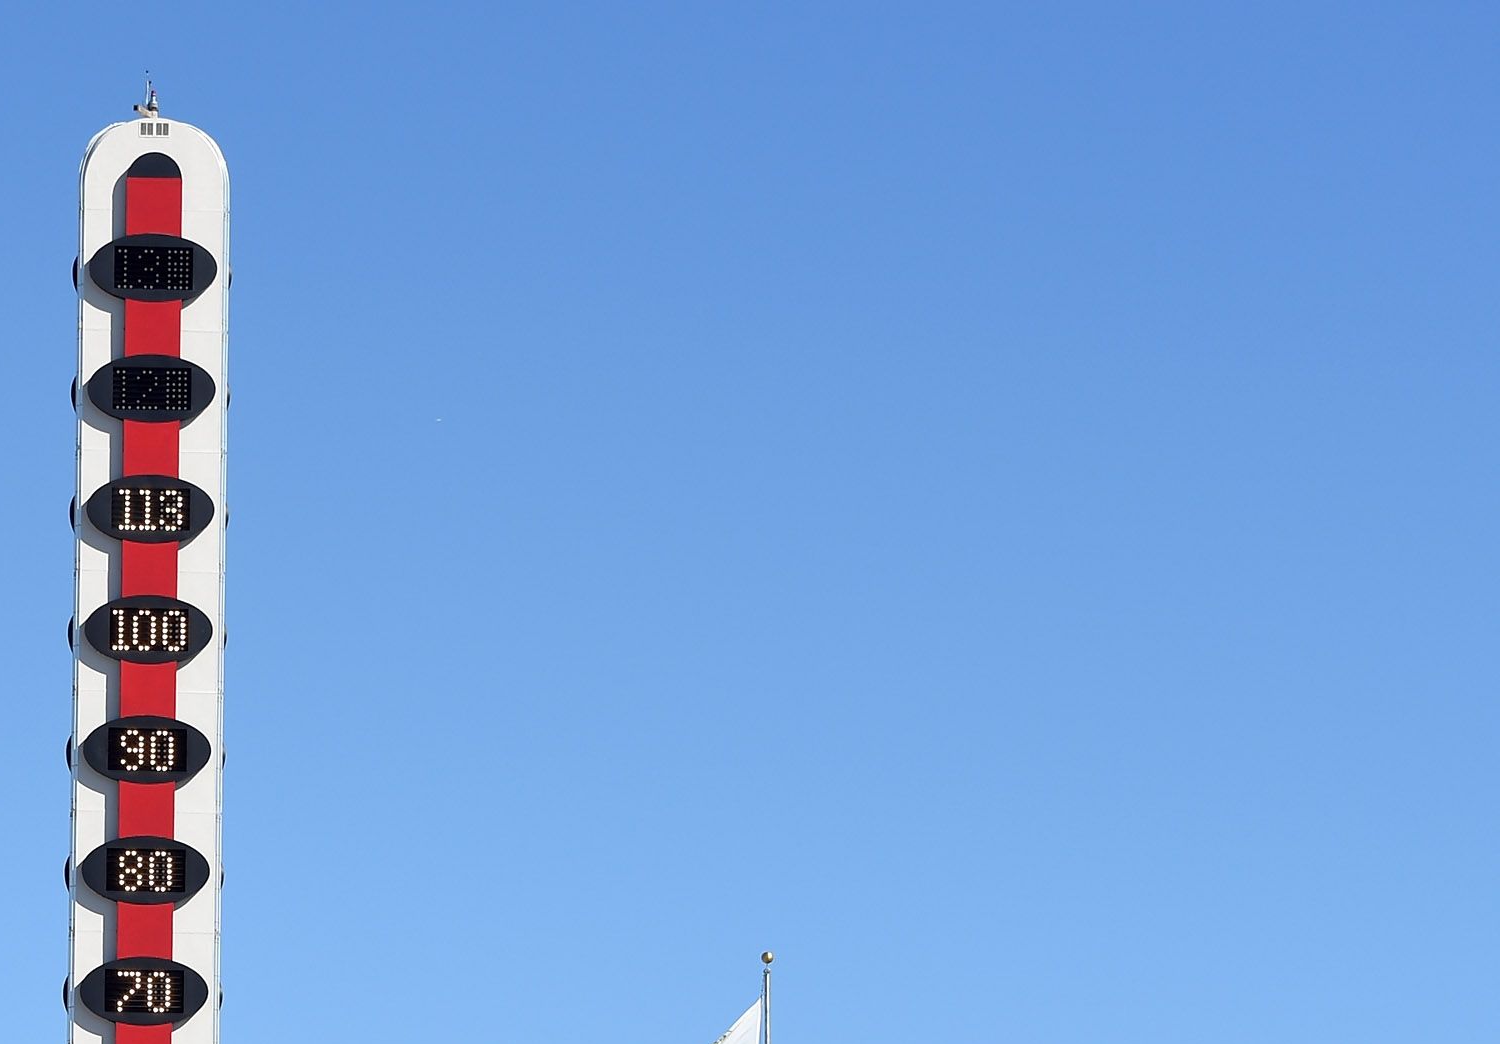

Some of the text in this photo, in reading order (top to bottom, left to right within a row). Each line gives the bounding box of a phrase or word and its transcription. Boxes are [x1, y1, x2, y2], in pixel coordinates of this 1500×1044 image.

[118, 489, 184, 532] 113
[111, 609, 187, 652] 100
[120, 729, 175, 772] 90
[118, 850, 173, 893] 80
[116, 970, 172, 1013] 70
